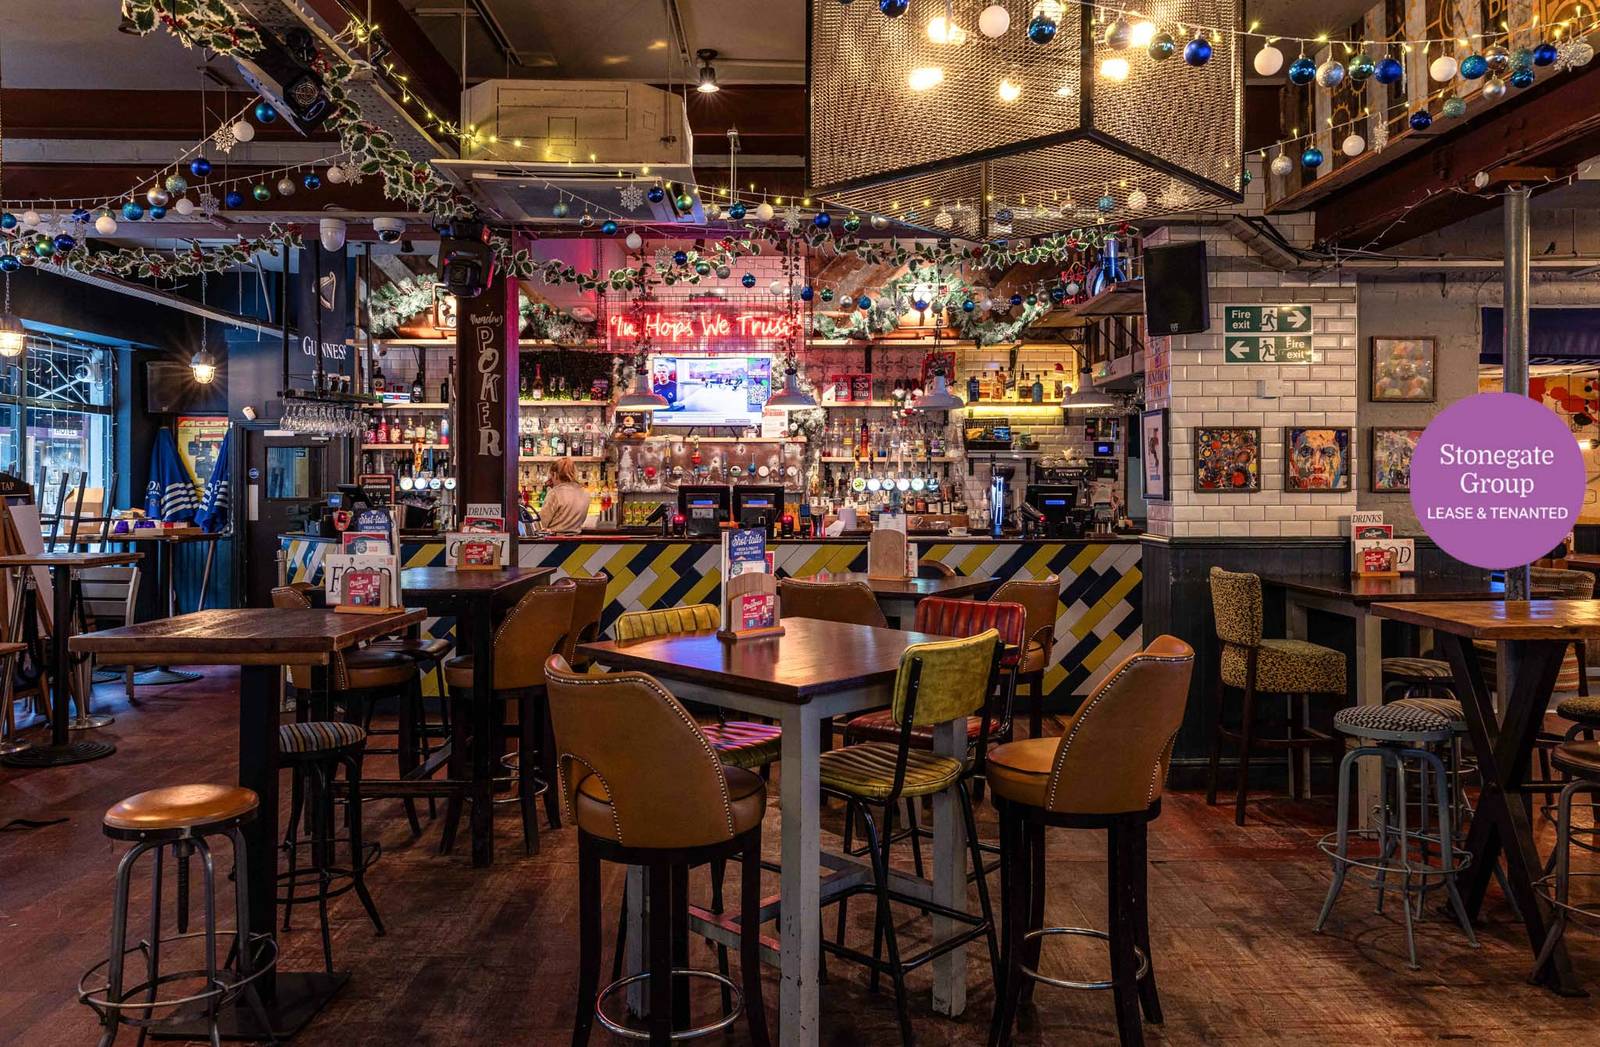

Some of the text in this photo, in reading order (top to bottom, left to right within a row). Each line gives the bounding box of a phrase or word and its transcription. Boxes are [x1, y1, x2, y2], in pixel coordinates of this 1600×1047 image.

[1231, 310, 1251, 319] Fire
[646, 312, 694, 342] Hops
[701, 314, 730, 336] We
[1232, 320, 1250, 329] exit
[1286, 338, 1305, 348] Fire
[1286, 350, 1305, 359] exit
[476, 326, 503, 456] POKER
[467, 507, 500, 516] DRINKS
[1352, 514, 1382, 523] DRINKS
